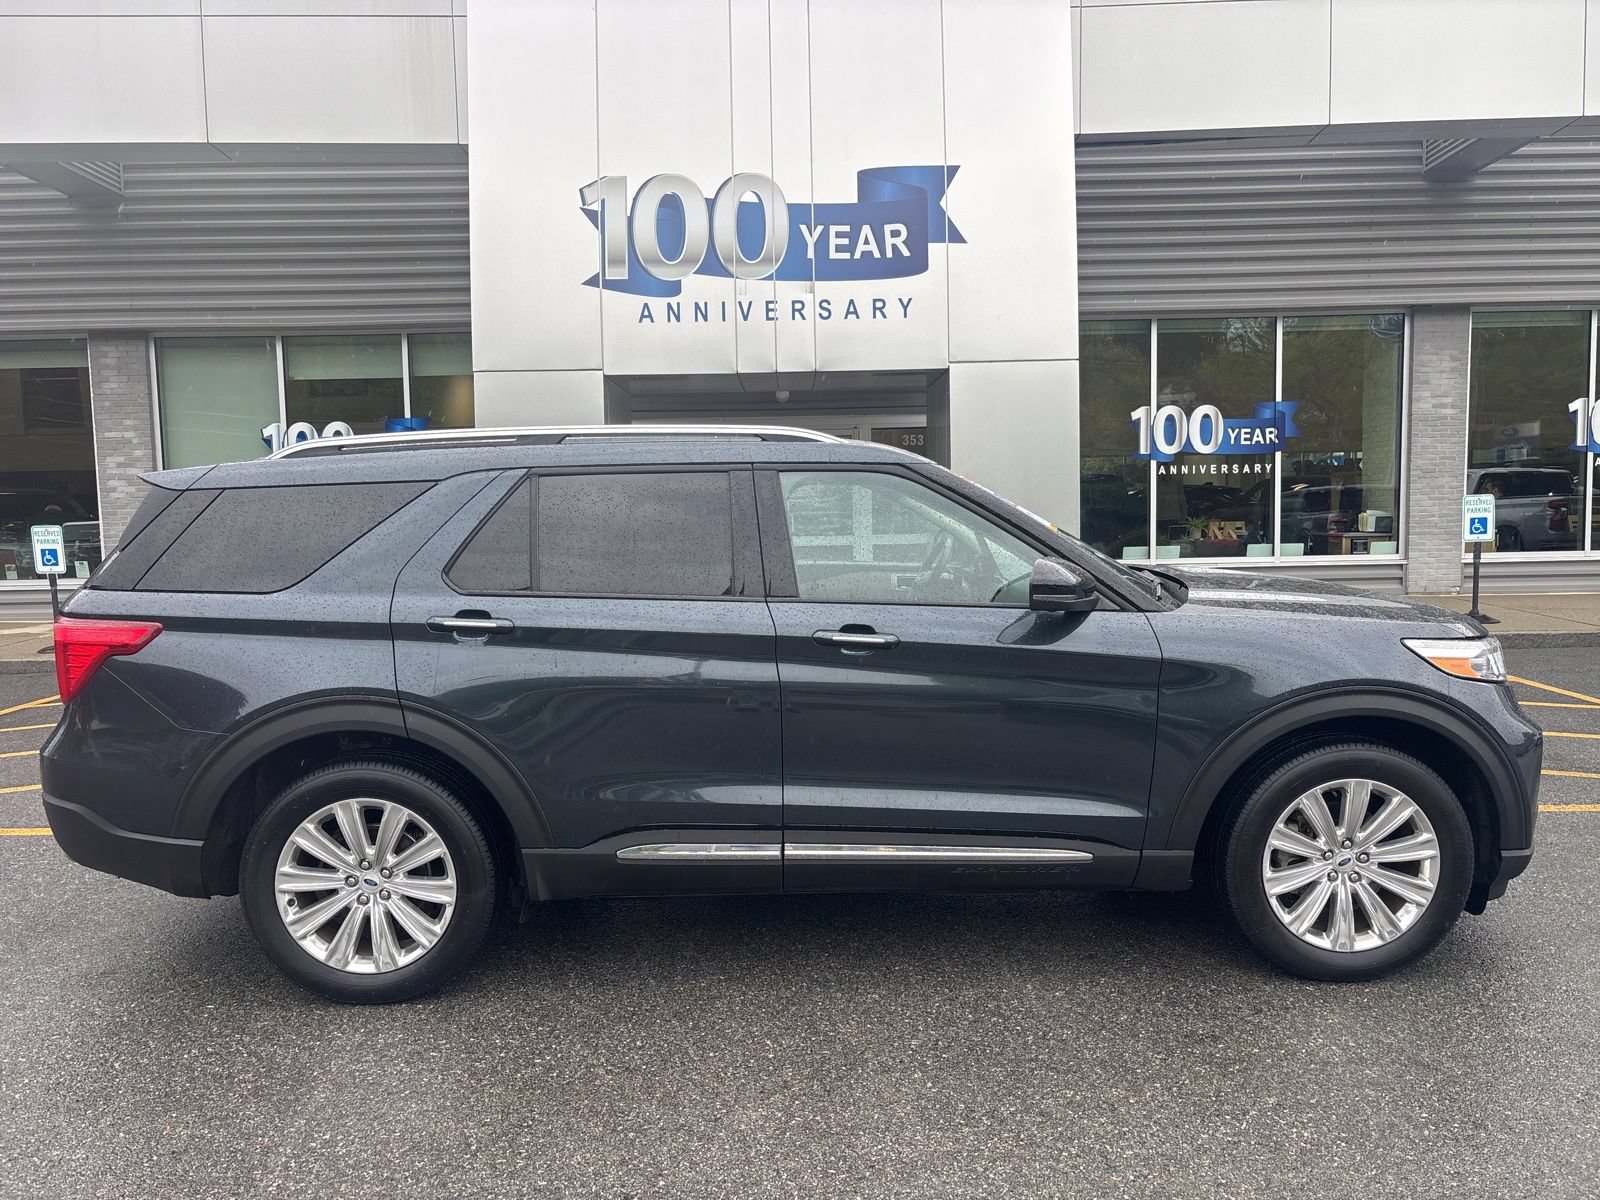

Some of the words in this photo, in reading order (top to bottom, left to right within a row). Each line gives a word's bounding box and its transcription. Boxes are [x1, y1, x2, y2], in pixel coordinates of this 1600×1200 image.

[579, 172, 790, 281] 100
[799, 222, 912, 260] YEAR
[638, 297, 913, 324] ANNIVERSARY
[902, 434, 924, 446] 353
[1130, 404, 1224, 455] 100
[1227, 427, 1279, 446] YEAR
[1158, 463, 1273, 476] ANNIVERSARY
